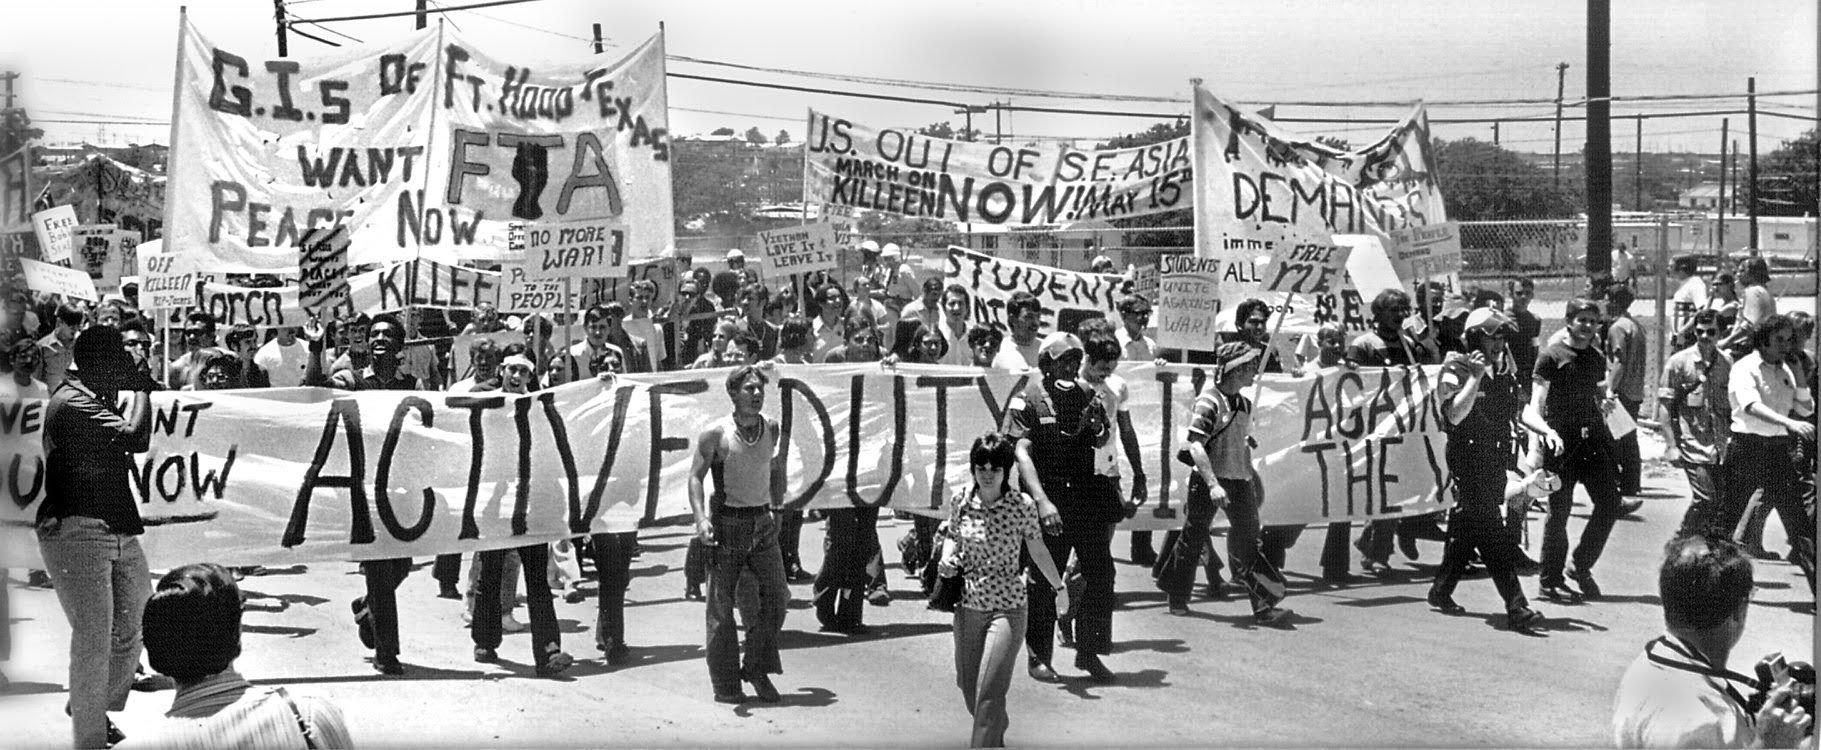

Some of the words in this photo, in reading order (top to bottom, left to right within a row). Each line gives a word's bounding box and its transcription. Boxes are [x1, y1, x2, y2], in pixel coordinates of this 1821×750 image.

[379, 53, 427, 97] OF
[444, 43, 493, 113] FT.
[500, 66, 574, 122] HOOD
[580, 68, 669, 161] TEXAS
[297, 145, 424, 188] WANT
[988, 147, 1040, 180] OF
[1056, 152, 1117, 182] S.E.
[1123, 138, 1189, 180] ASIA
[447, 128, 623, 218] FTA
[835, 157, 899, 182] MARCH
[908, 170, 936, 190] ON
[832, 175, 936, 217] KILLEEN
[1076, 184, 1138, 220] MAY
[1233, 172, 1427, 233] DEMANDS
[44, 217, 73, 231] FREE
[397, 189, 484, 248] NOW
[531, 230, 550, 247] NO
[558, 227, 605, 245] MORE
[1223, 233, 1274, 250] imme
[542, 246, 604, 271] WAR!
[766, 243, 796, 257] LOVE
[801, 241, 815, 252] IT
[773, 253, 813, 268] LEAVE
[816, 251, 833, 262] IT
[1290, 245, 1337, 263] FREE
[1161, 254, 1221, 274] STUDENTS
[1223, 261, 1262, 283] ALL
[143, 273, 192, 292] KILLEEN
[524, 283, 537, 292] TO
[544, 283, 559, 291] THE
[1163, 281, 1211, 294] UNITE
[1162, 298, 1219, 312] AGAINST
[1165, 316, 1211, 336] WAR!
[281, 379, 709, 548] ACTIVE
[1302, 366, 1446, 443] AGAIN
[128, 444, 238, 503] NOW
[1302, 436, 1404, 517] THE
